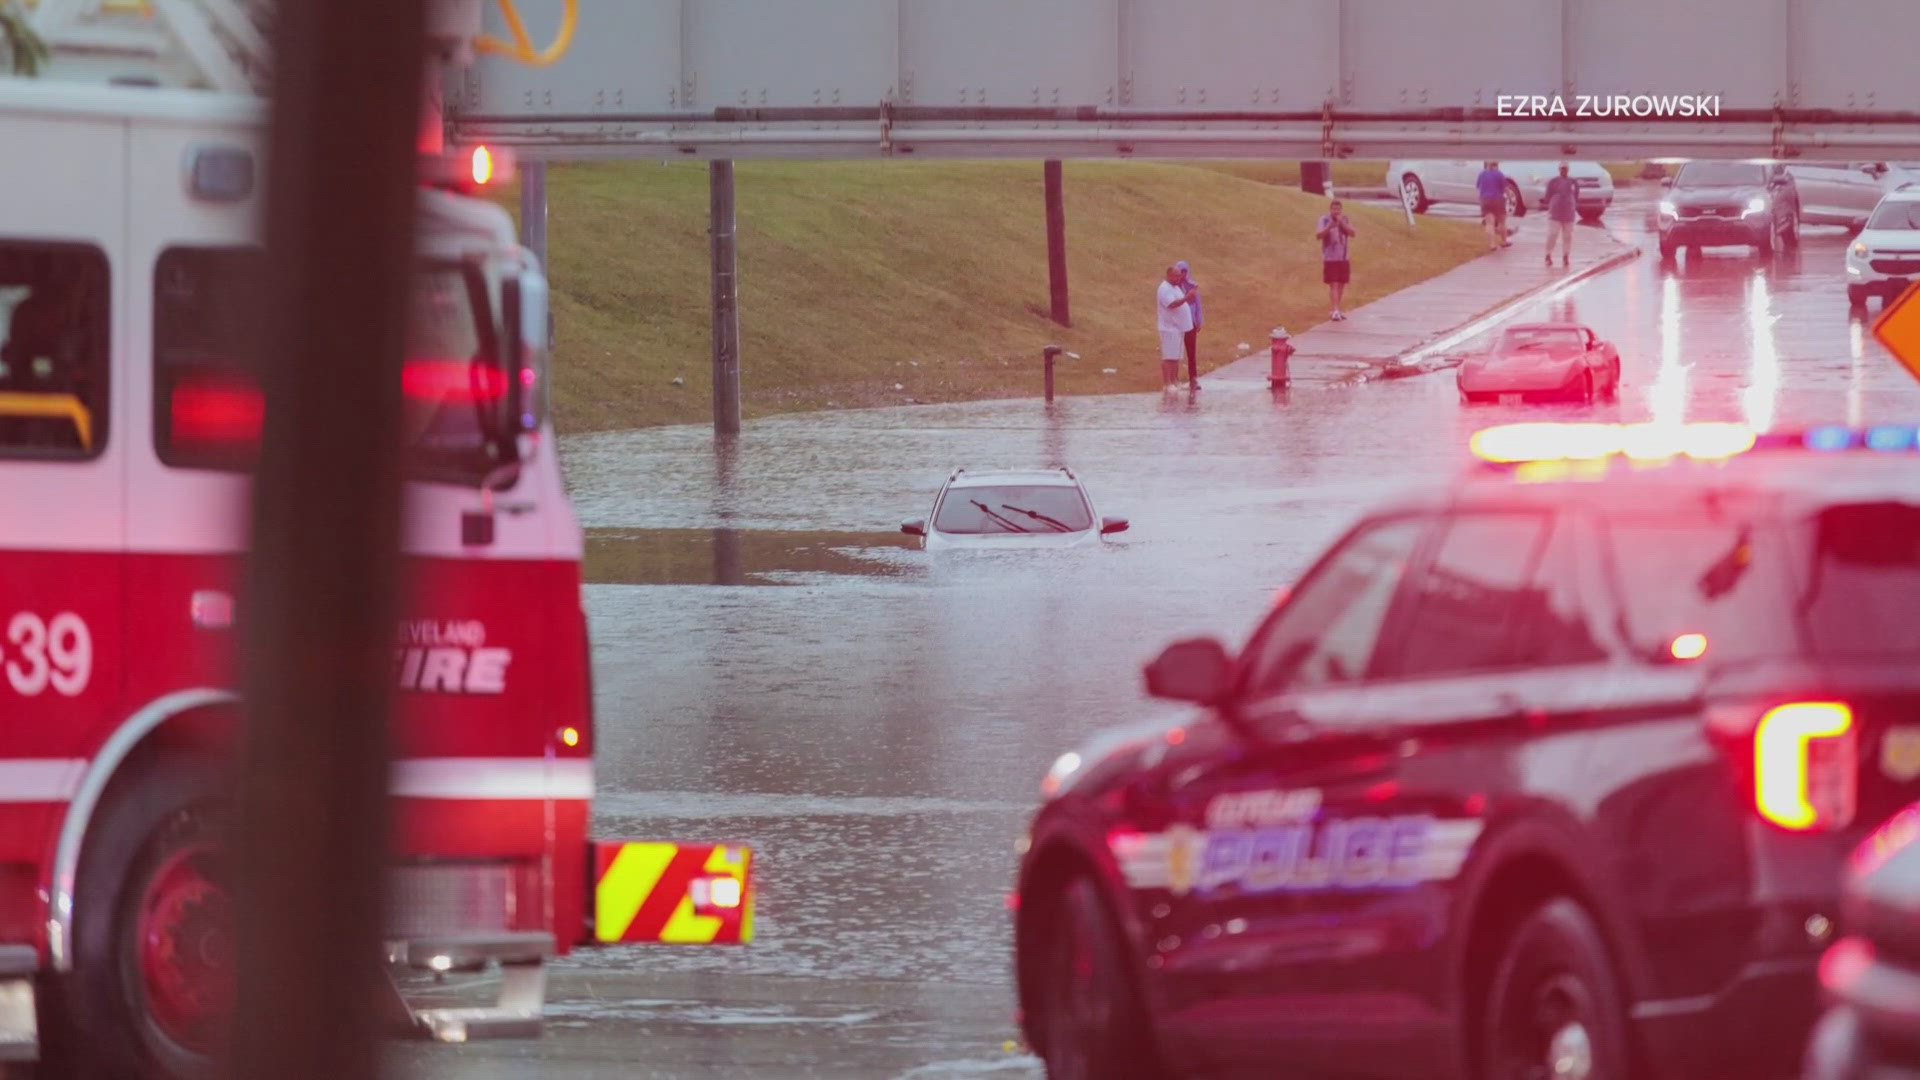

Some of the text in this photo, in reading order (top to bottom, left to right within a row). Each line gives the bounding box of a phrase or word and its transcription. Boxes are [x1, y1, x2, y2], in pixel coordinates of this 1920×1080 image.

[0, 610, 93, 697] 39
[396, 646, 512, 694] IRE
[1200, 816, 1434, 890] POLICE
